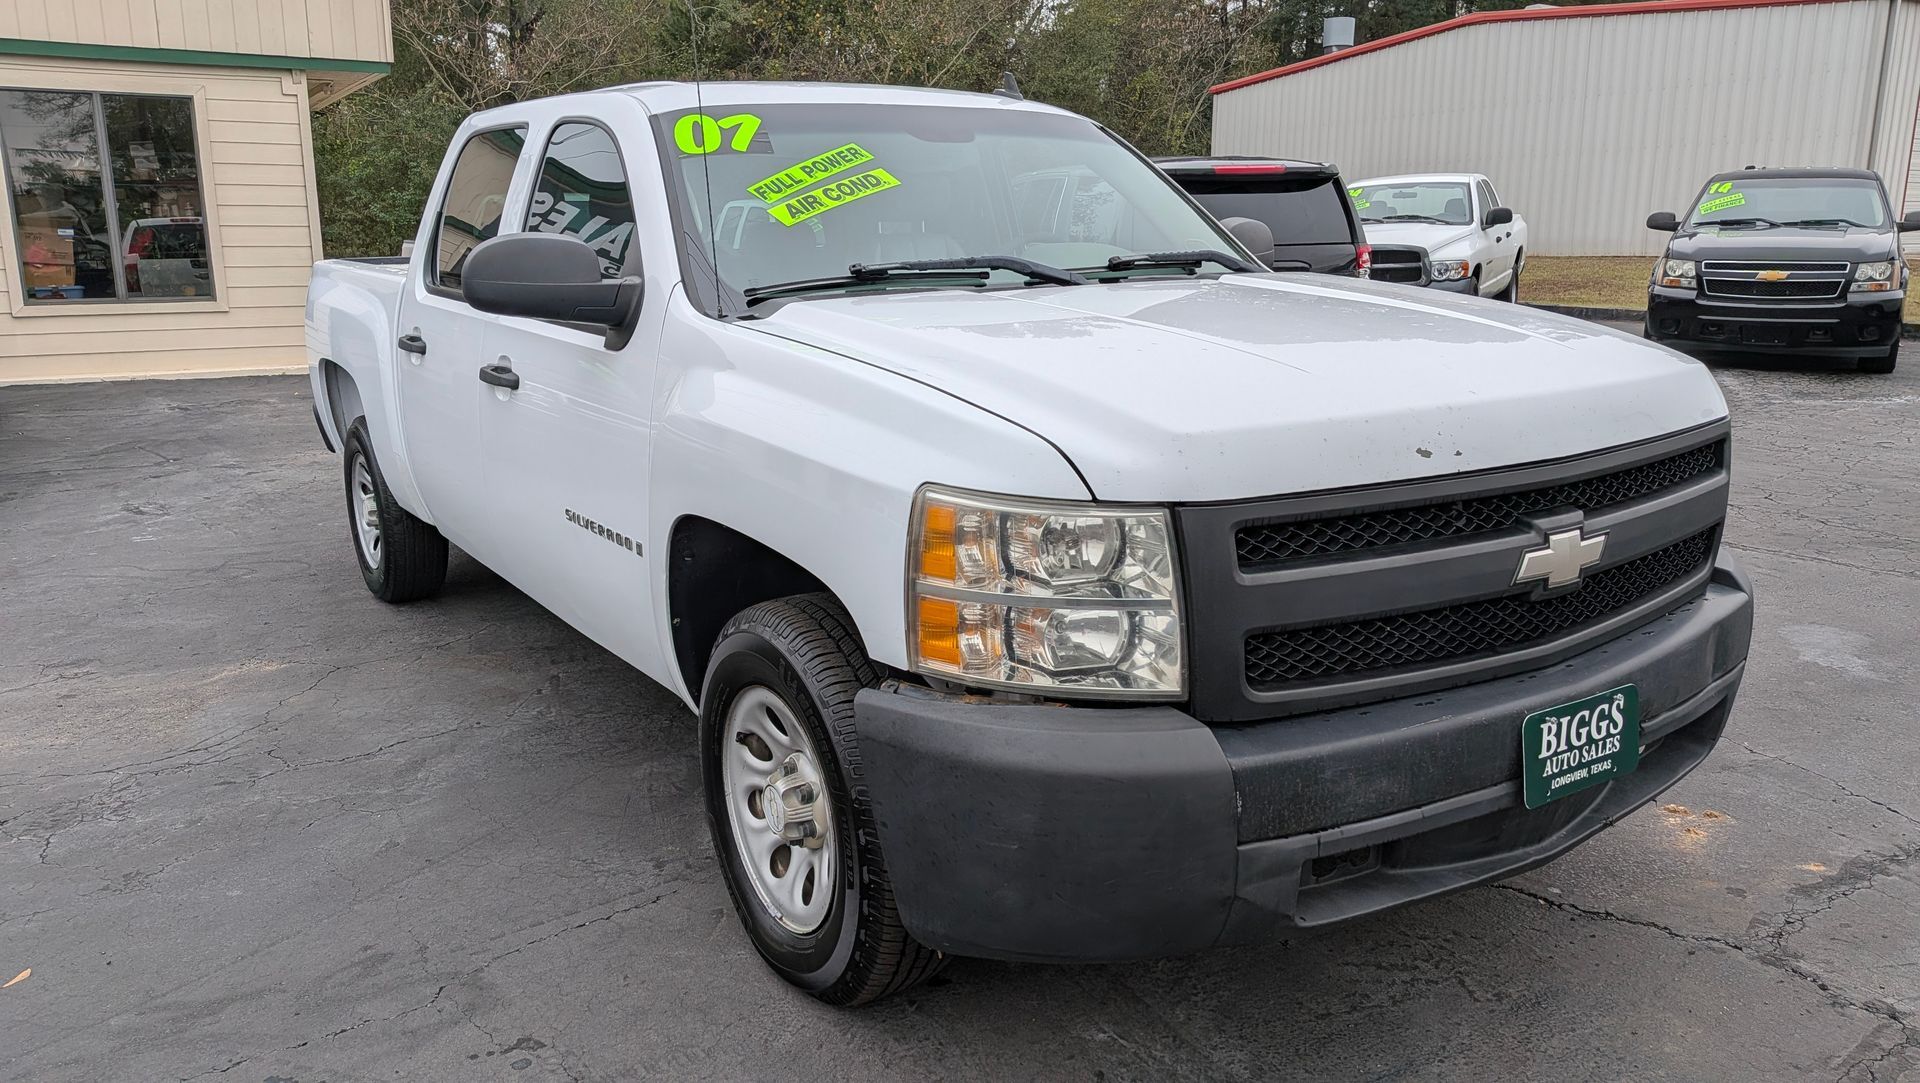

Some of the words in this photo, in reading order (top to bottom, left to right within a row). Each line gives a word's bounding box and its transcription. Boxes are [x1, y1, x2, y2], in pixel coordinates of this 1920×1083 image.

[673, 113, 762, 154] 07
[753, 173, 803, 201] FULL
[801, 147, 865, 178] POWER
[1708, 182, 1733, 194] 14
[784, 195, 825, 220] AIR
[821, 172, 888, 202] COND.
[565, 508, 633, 552] SILVERADO
[1538, 698, 1624, 759] BIGGS
[1542, 749, 1580, 777] AUTO
[1581, 735, 1620, 763] SALES
[1551, 767, 1589, 790] LONGVIEW,
[1590, 759, 1612, 775] TEXAS
